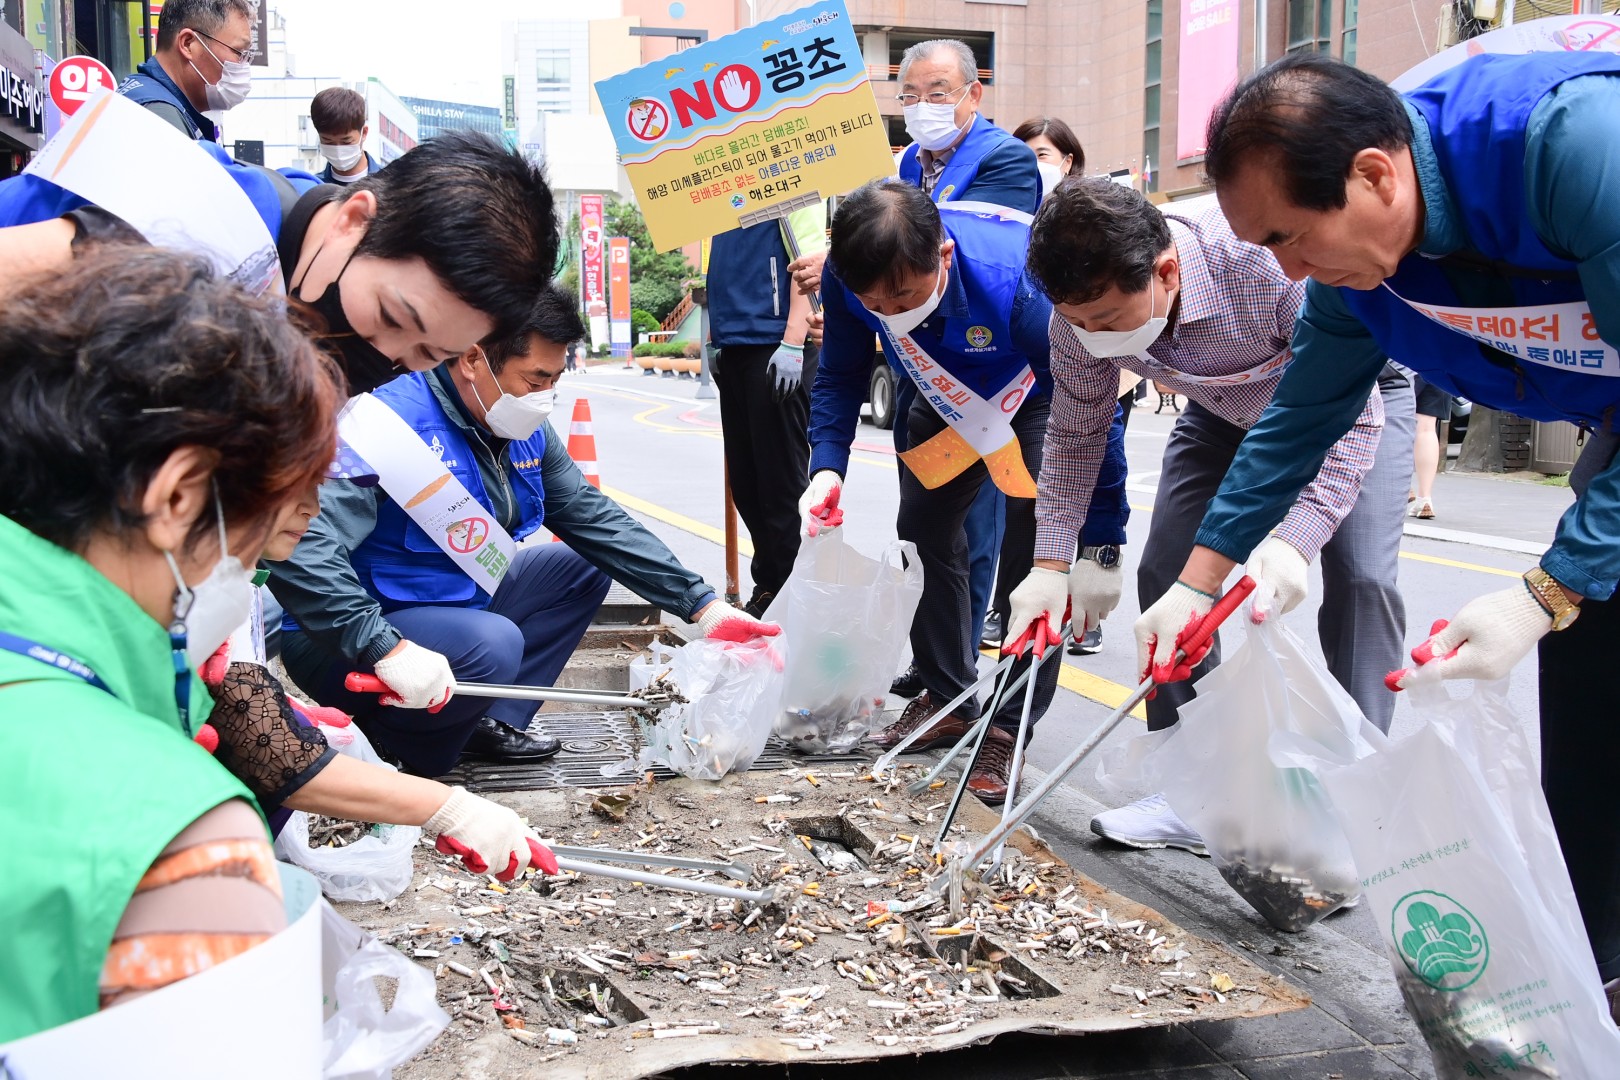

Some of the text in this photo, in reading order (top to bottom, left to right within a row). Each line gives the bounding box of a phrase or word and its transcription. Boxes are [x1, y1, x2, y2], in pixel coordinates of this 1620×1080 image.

[1206, 7, 1231, 28] SALE
[60, 65, 103, 101] 약
[669, 37, 847, 129] NO 꽁초
[412, 105, 465, 119] SHILLA STAY
[646, 113, 874, 201] 해양 미세플라스틱이 되어 물고기 먹이가 됩니다
[693, 117, 809, 166] 바다로 흘러간 담배꽁초!
[689, 144, 837, 204] 담배꽁초 없는 아름다운 해운대
[748, 175, 802, 202] 해운대구
[1413, 305, 1559, 342] 배꽁초
[1526, 346, 1605, 369] 해운대
